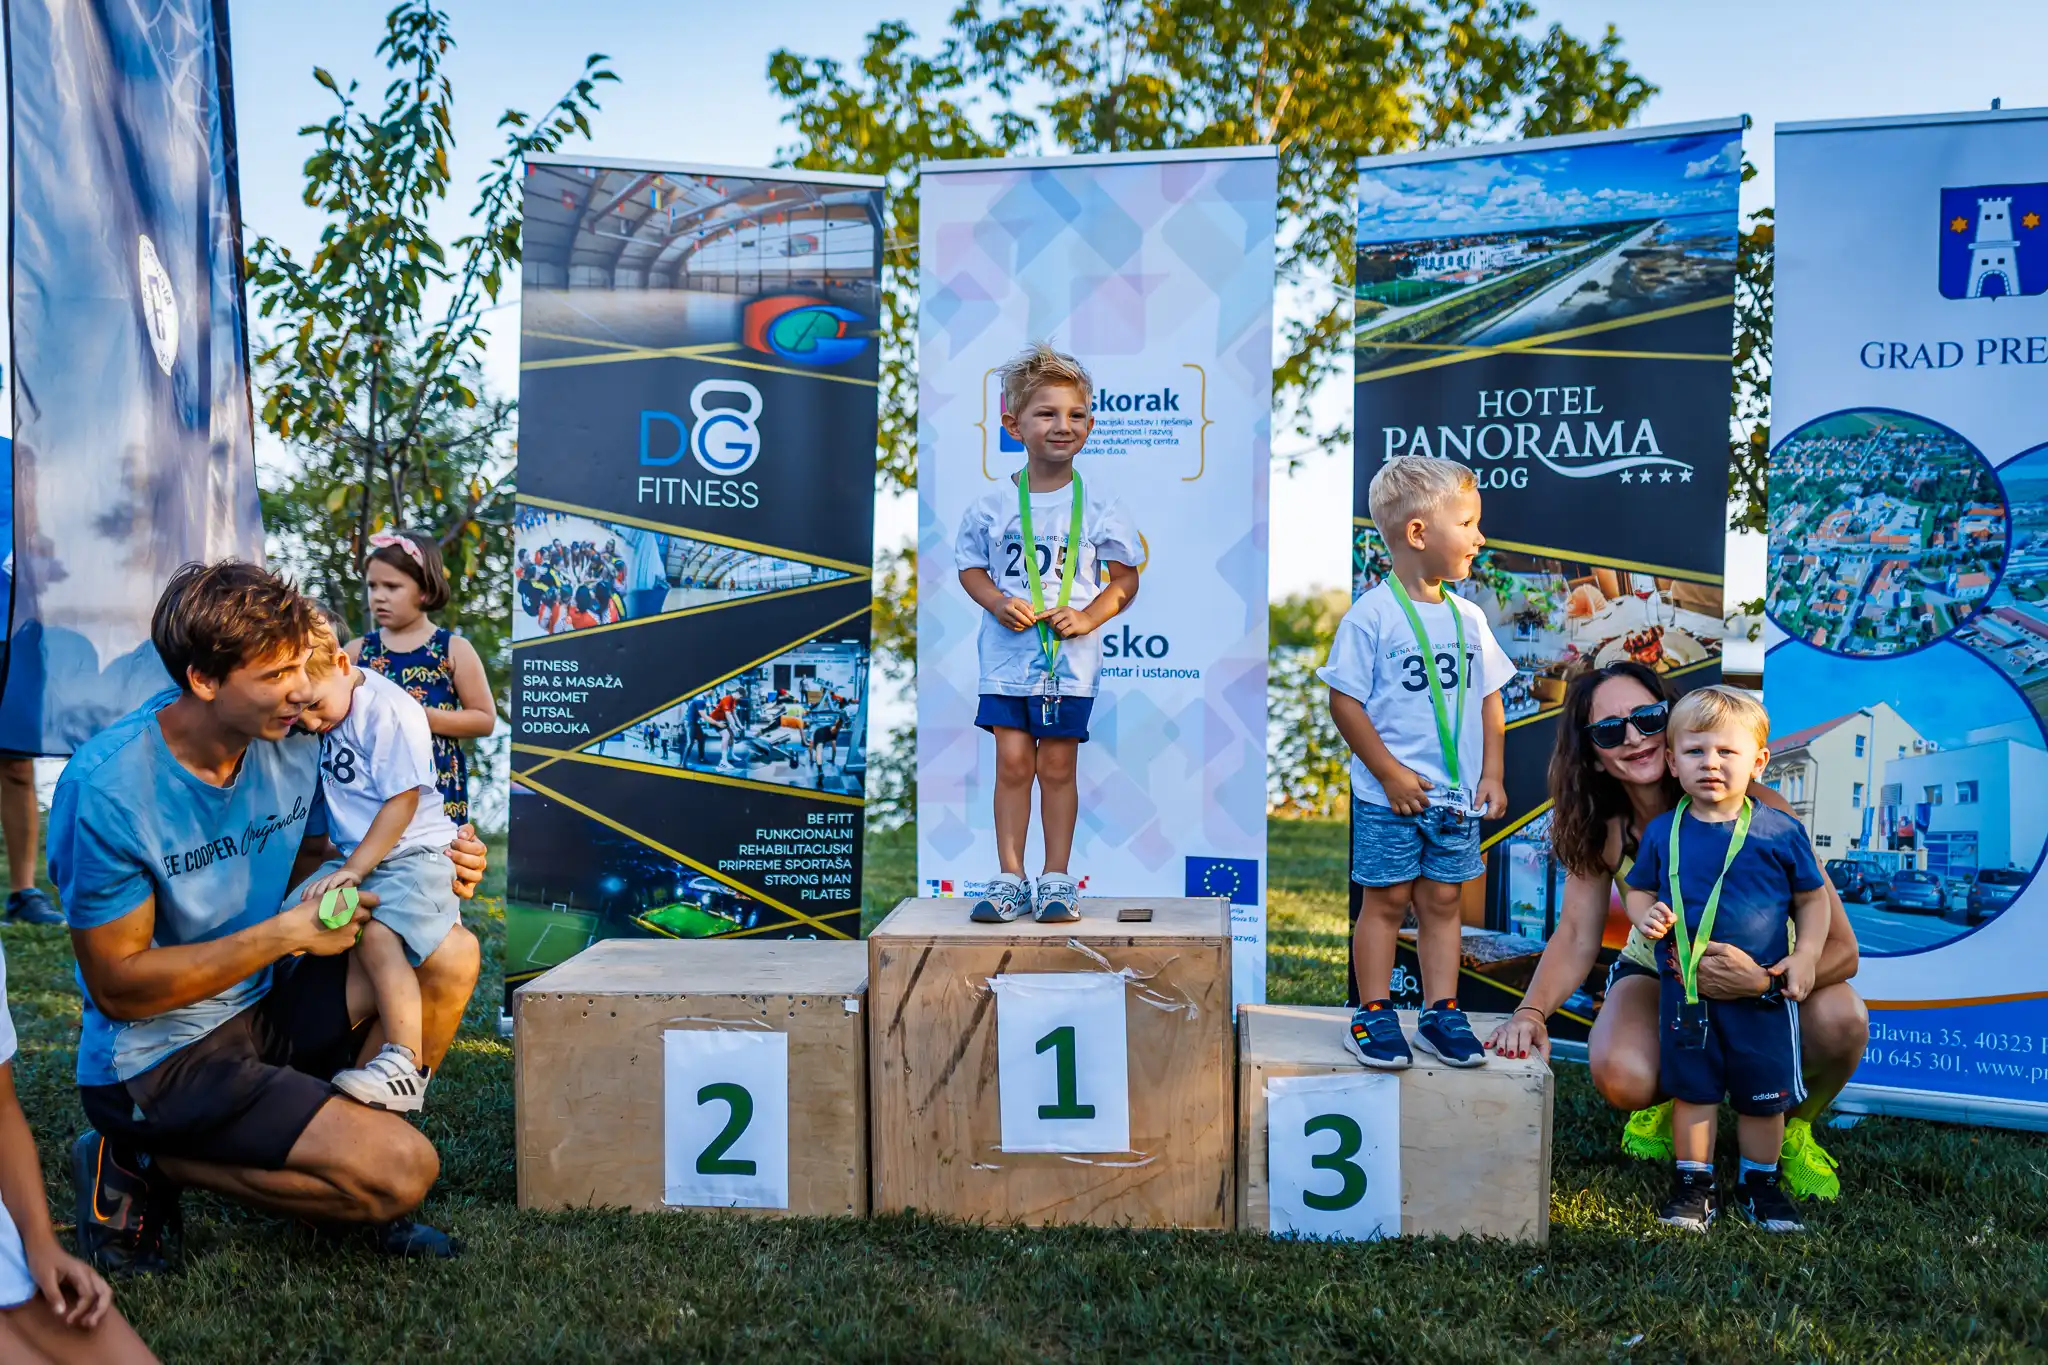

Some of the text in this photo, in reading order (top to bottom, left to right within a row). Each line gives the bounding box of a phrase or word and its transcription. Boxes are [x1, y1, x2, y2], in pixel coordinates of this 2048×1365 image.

[1860, 337, 2048, 369] GRAD PRE
[1477, 386, 1604, 417] HOTEL
[1149, 429, 1173, 438] razvoj
[1382, 418, 1664, 462] PANORAMA
[1102, 437, 1152, 448] edukativnog
[1153, 438, 1180, 446] centra
[638, 476, 759, 508] FITNESS
[1102, 624, 1169, 659] sko
[523, 659, 579, 672] FITNESS
[1101, 666, 1133, 677] entar
[1142, 667, 1200, 679] ustanova
[523, 673, 623, 689] SPA & MASAŽA
[522, 691, 589, 703] RUKOMET
[522, 706, 575, 718] FUTSAL
[522, 722, 590, 734] ODBOJKA
[807, 813, 854, 824] BE FITT
[184, 836, 238, 873] COOPER
[241, 796, 308, 856] Originals
[756, 828, 854, 840] FUNKCIONALNI
[739, 844, 853, 855] REHABILITACIJSKI
[718, 857, 852, 870] PRIPREME SPORTAŠA
[764, 874, 852, 886] STRONG MAN
[801, 889, 851, 900] PILATES
[1868, 1022, 1932, 1044] Glavna
[1939, 1028, 1967, 1050] 35,
[1974, 1032, 2033, 1053] 40323
[1889, 1049, 1922, 1069] 645
[1929, 1052, 1969, 1077] 301,
[1035, 1026, 1096, 1120] 1
[1752, 1092, 1780, 1101] adidas
[695, 1082, 757, 1176] 2
[1302, 1113, 1369, 1211] 3
